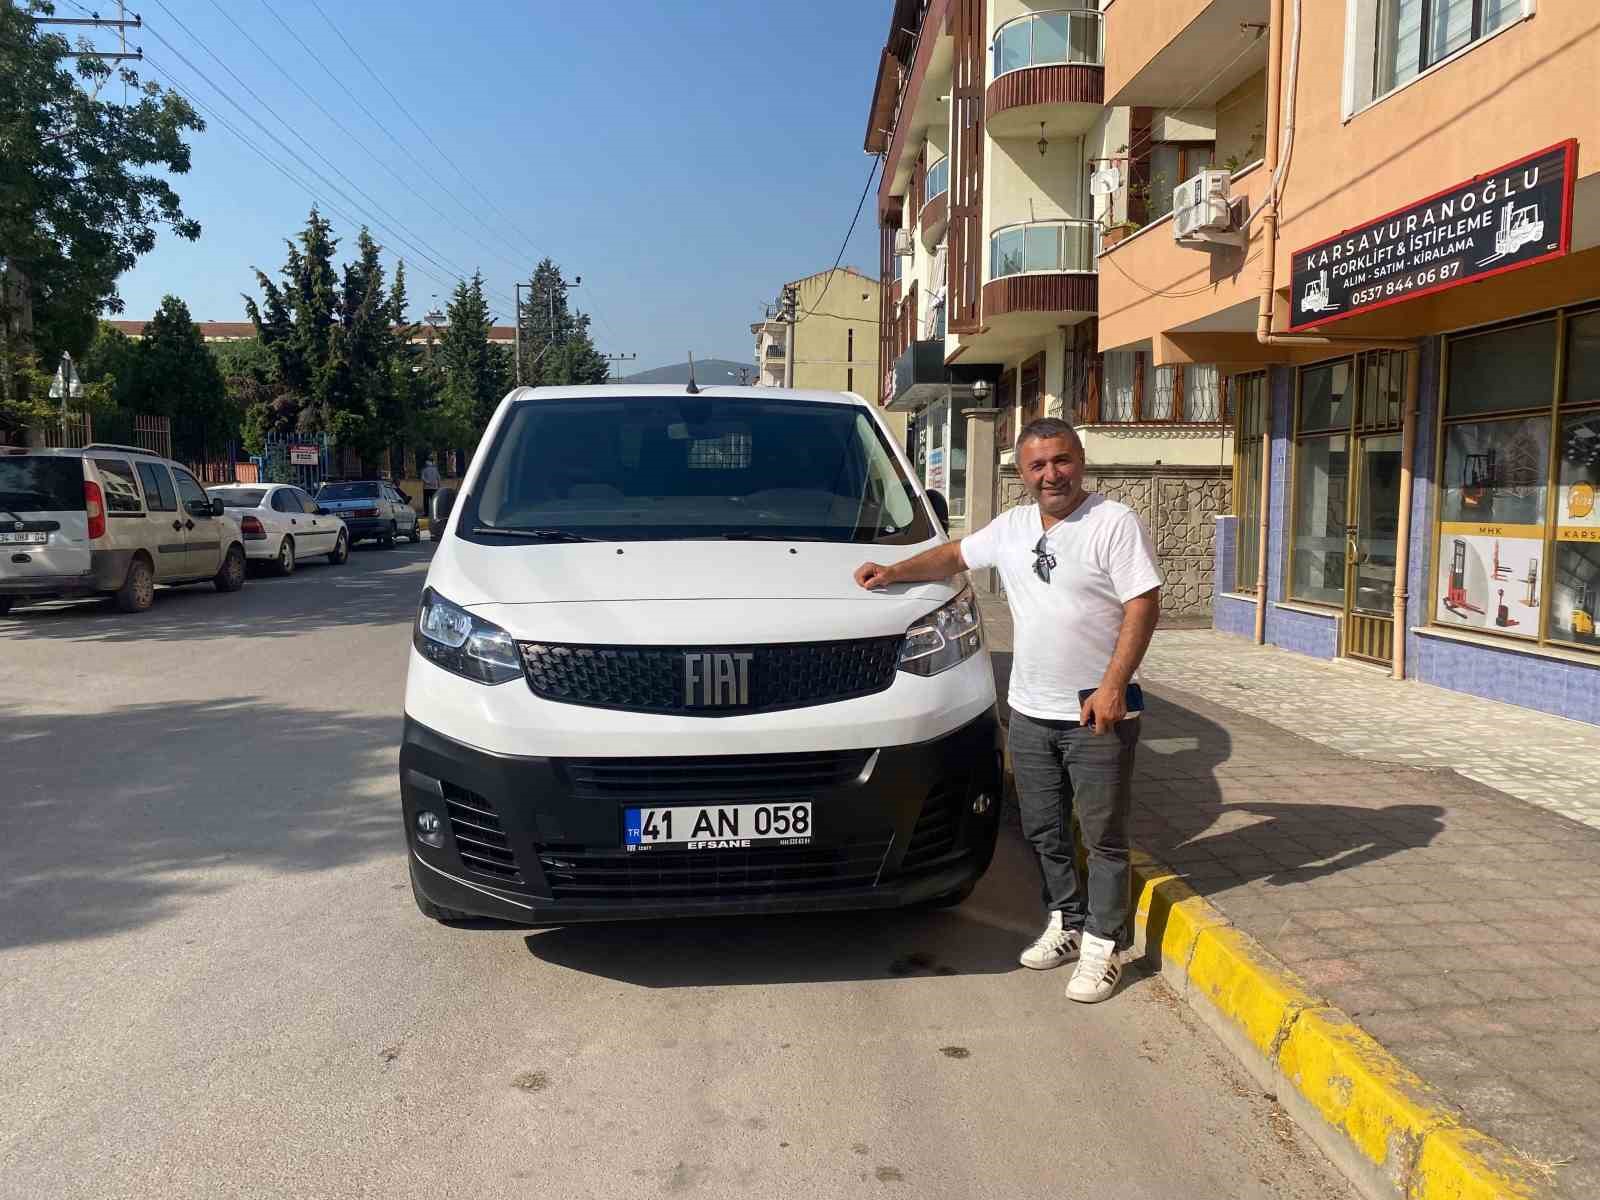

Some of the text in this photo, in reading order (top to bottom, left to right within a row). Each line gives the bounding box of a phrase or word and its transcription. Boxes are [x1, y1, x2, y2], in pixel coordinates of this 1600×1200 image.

[1307, 167, 1539, 271] KARSAVURANOĞLU
[1332, 210, 1493, 279] FORKLİFT & İSTİFLEME
[1343, 273, 1366, 289] ALIM
[1374, 261, 1404, 278] SATIM
[1413, 237, 1474, 265] KİRALAMA
[1352, 261, 1460, 305] 0537 844 06 87
[1564, 530, 1600, 540] KARS
[686, 653, 753, 706] FIAT
[628, 805, 809, 840] TR 41 AN 058
[687, 839, 751, 850] EFSANE
